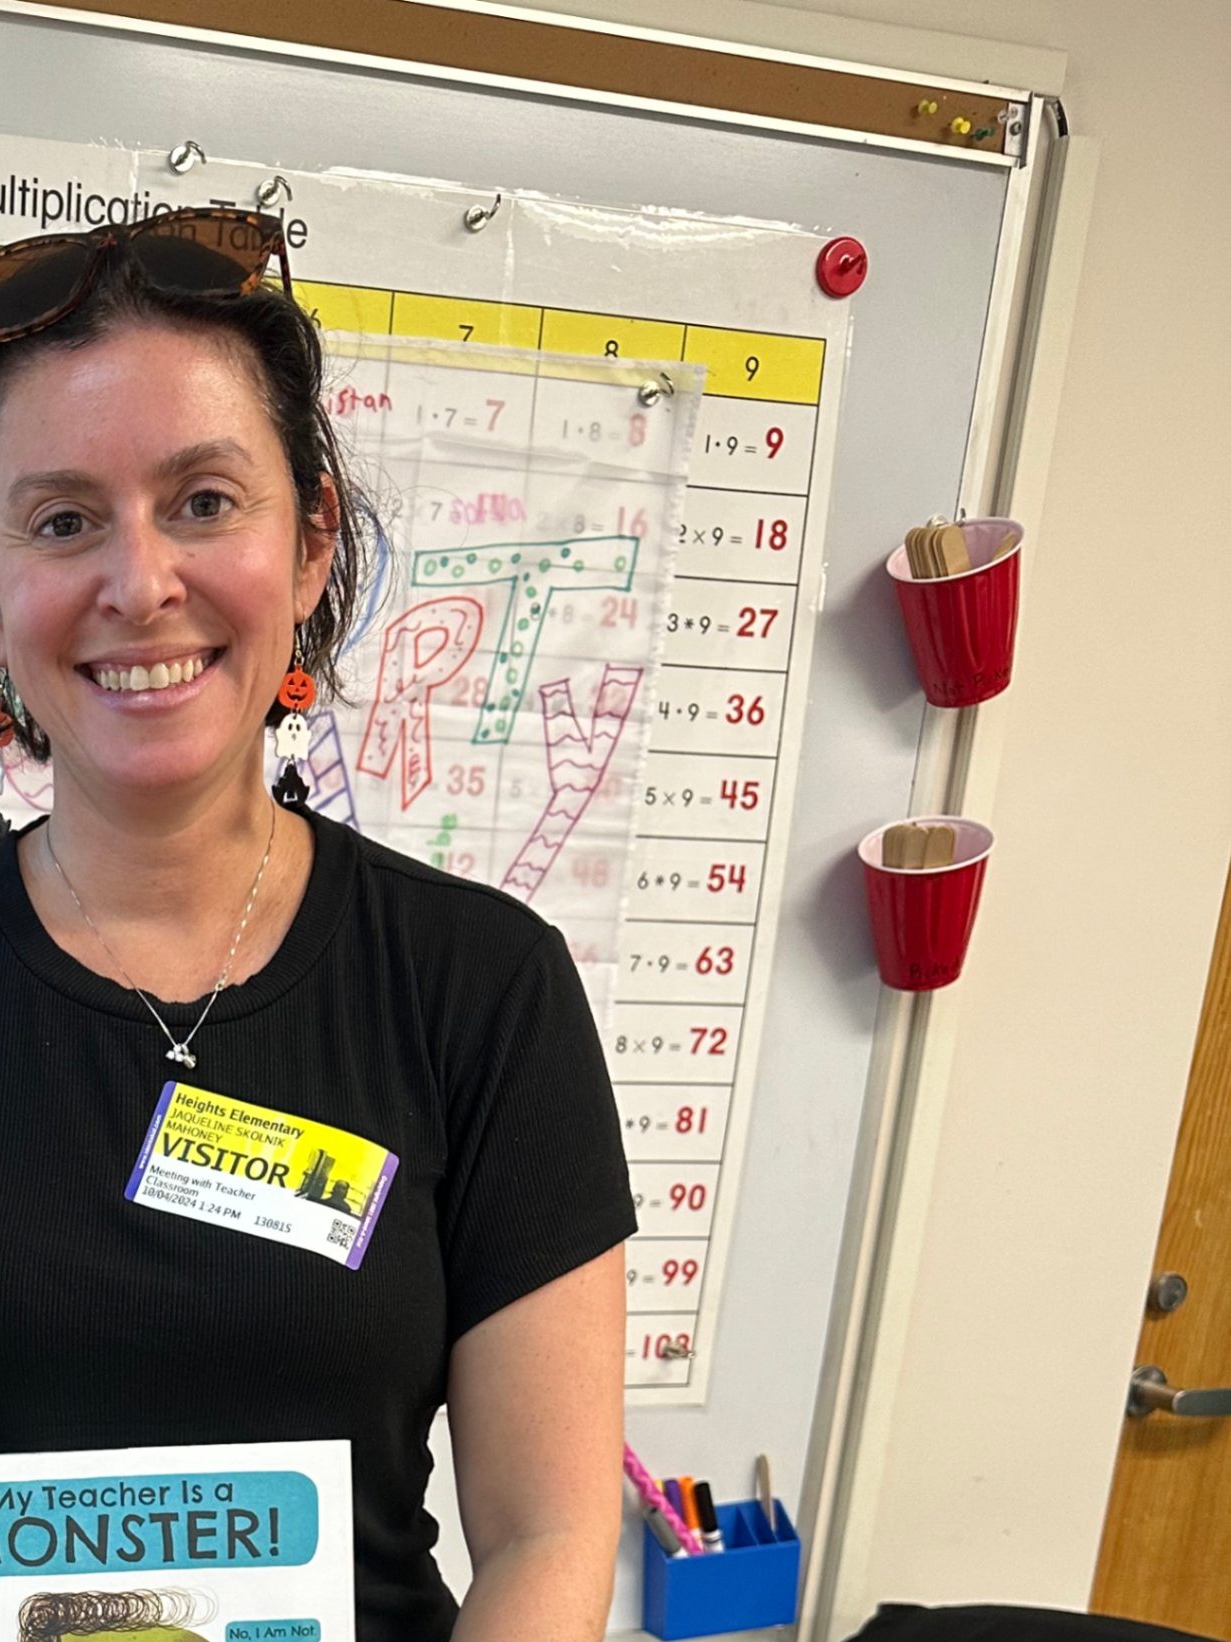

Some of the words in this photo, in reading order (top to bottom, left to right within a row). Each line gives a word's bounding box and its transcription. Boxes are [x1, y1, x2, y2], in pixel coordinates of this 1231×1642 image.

[746, 356, 759, 381] 9
[766, 427, 783, 459] 9
[756, 519, 787, 550] 18
[737, 607, 778, 638] 27
[726, 694, 764, 726] 36
[721, 780, 759, 810] 45
[707, 864, 745, 893] 54
[696, 947, 734, 975] 63
[690, 1028, 727, 1055] 72
[170, 1108, 233, 1134] JAQUELINE
[237, 1126, 285, 1148] SKOLNIK
[175, 1093, 226, 1117] Heights
[229, 1108, 305, 1140] Elementary
[675, 1106, 707, 1134] 81
[166, 1120, 223, 1144] MAHONEY
[162, 1133, 290, 1188] VISITOR
[145, 1175, 200, 1198] Classroom
[149, 1164, 190, 1186] Meeting
[190, 1174, 212, 1190] with
[215, 1181, 257, 1201] Teacher
[670, 1184, 706, 1211] 90
[223, 1206, 242, 1220] PM
[662, 1259, 698, 1286] 99
[42, 1483, 170, 1511] Teacher
[182, 1480, 203, 1504] Is
[214, 1481, 234, 1503] a
[229, 1627, 252, 1642] No,
[263, 1625, 287, 1639] Am
